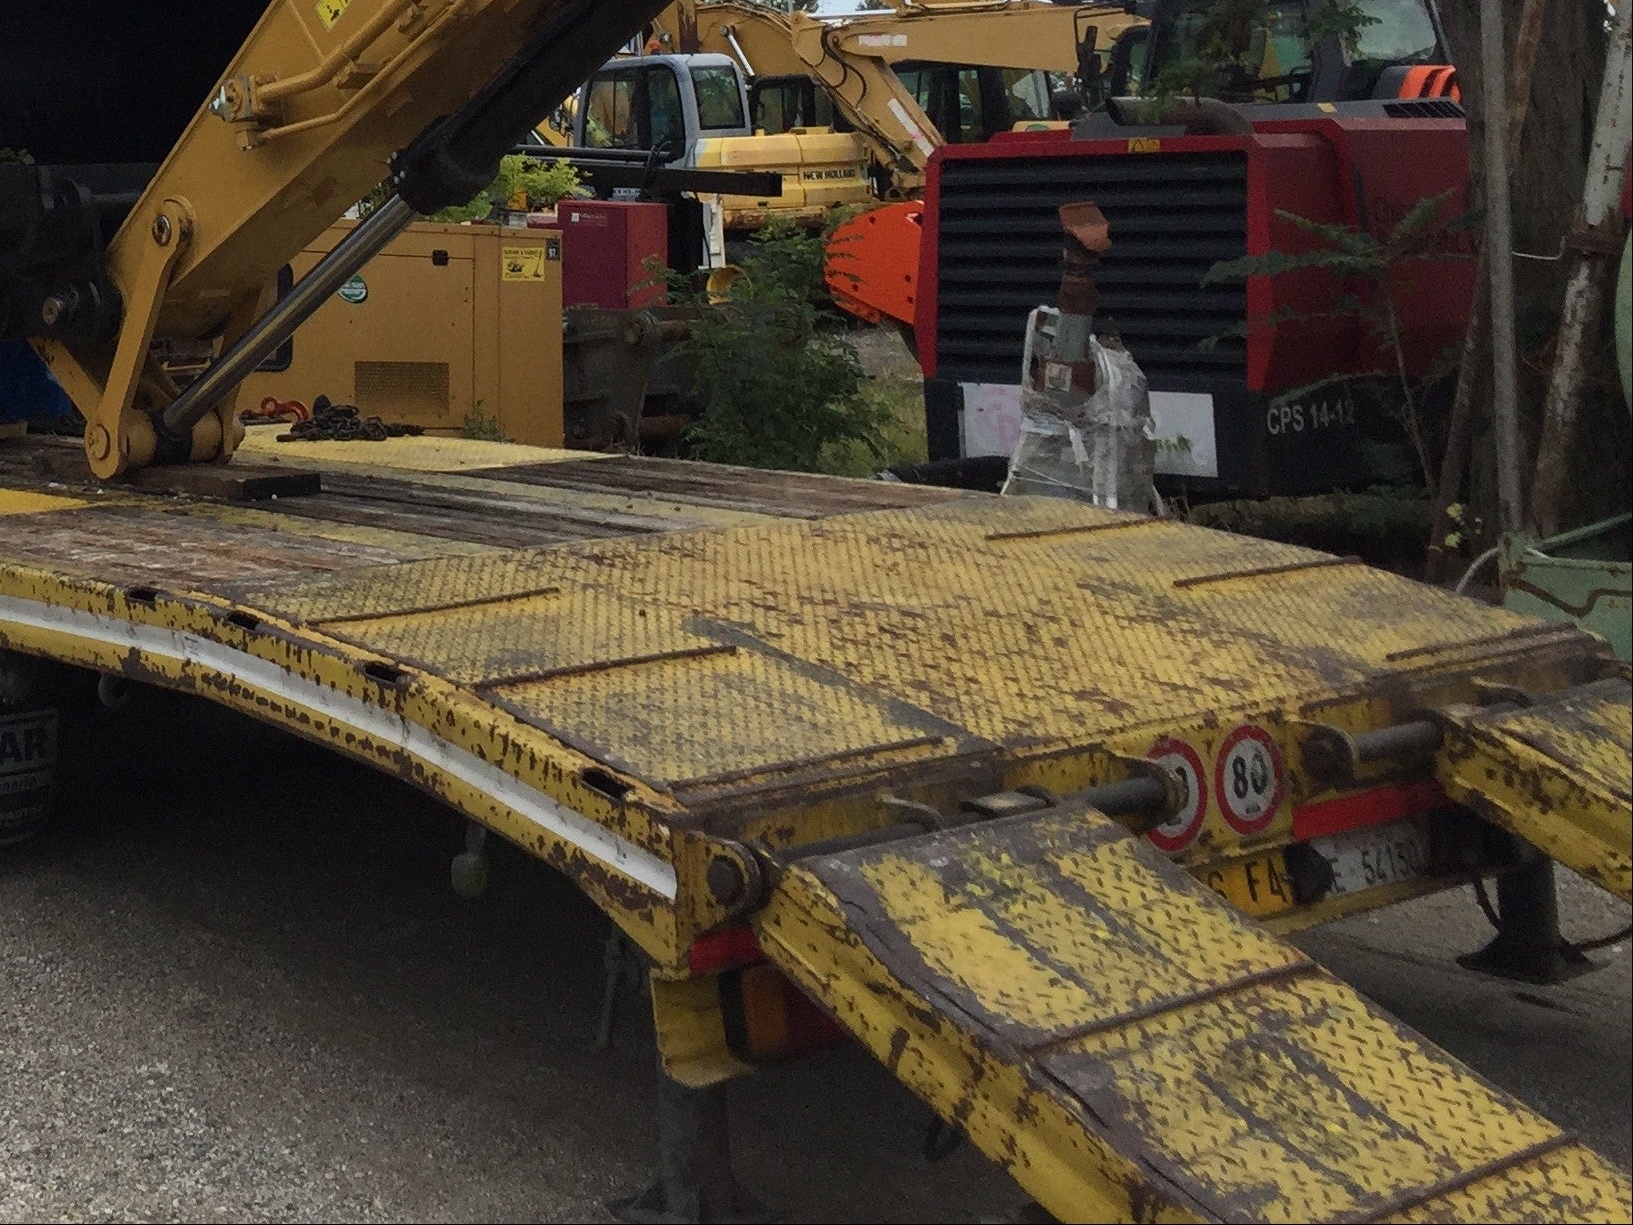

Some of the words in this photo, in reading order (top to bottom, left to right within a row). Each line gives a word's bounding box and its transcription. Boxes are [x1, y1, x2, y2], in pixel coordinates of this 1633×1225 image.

[803, 170, 823, 180] NEW
[1267, 404, 1305, 435] CPS
[1232, 746, 1268, 799] 80
